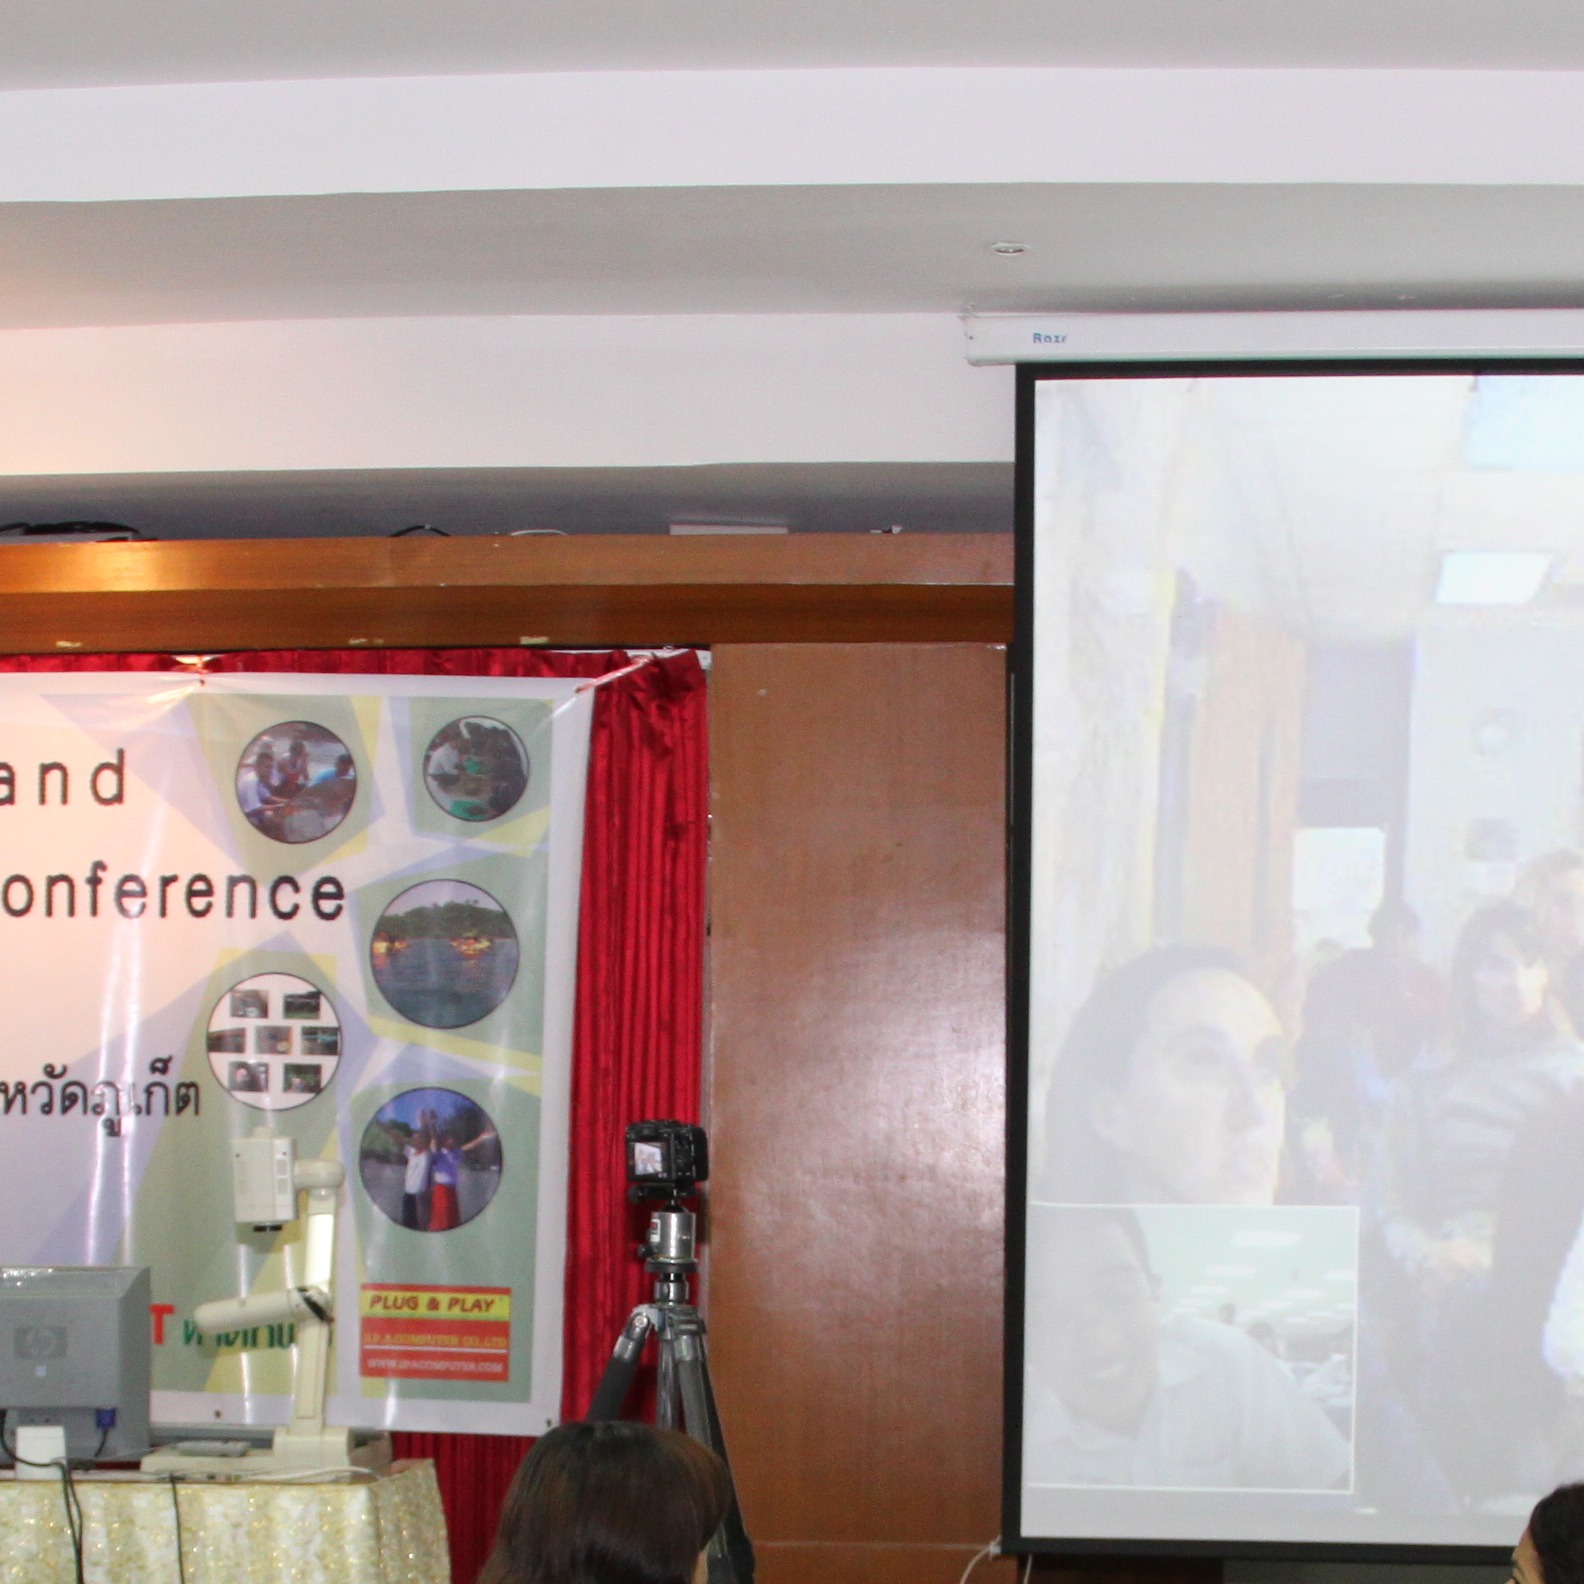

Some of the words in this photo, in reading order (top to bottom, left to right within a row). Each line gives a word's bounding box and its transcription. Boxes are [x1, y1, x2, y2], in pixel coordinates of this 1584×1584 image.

[369, 1295, 419, 1311] PLUG
[426, 1297, 441, 1312] &
[447, 1296, 495, 1313] PLAY
